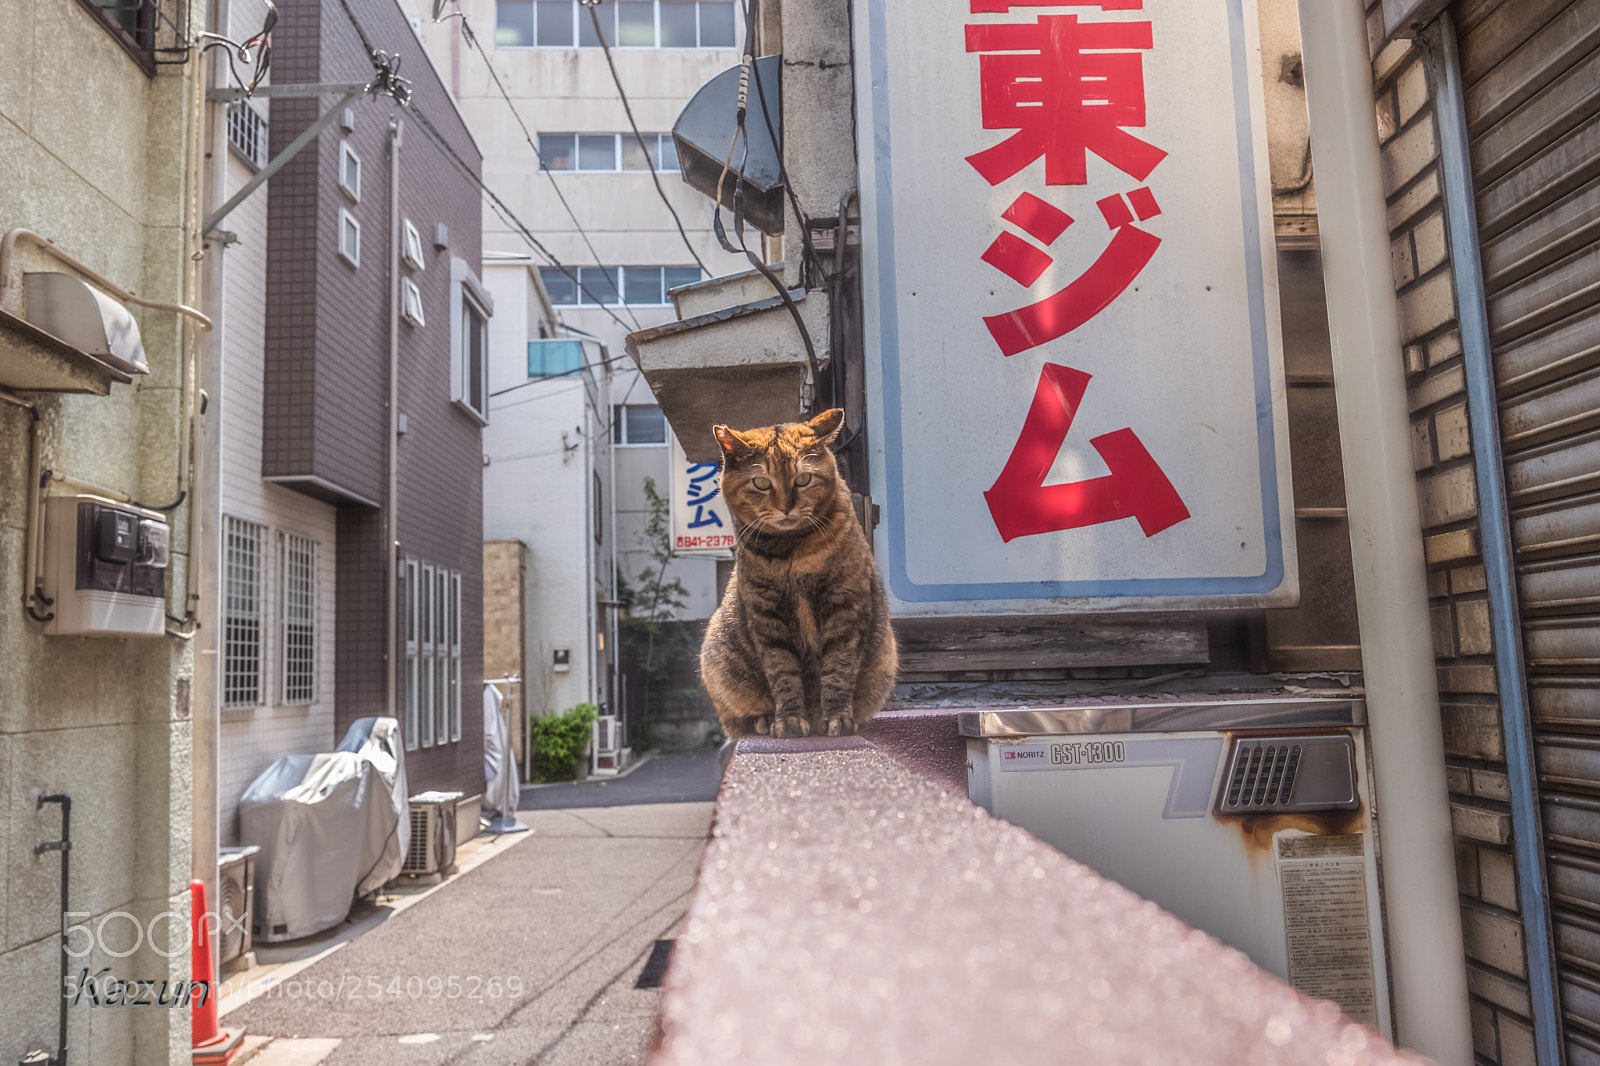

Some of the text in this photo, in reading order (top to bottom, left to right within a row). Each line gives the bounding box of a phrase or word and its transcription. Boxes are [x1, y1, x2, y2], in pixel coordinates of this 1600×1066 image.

[964, 0, 1191, 543] 東ジム
[1016, 751, 1045, 759] NORITZ
